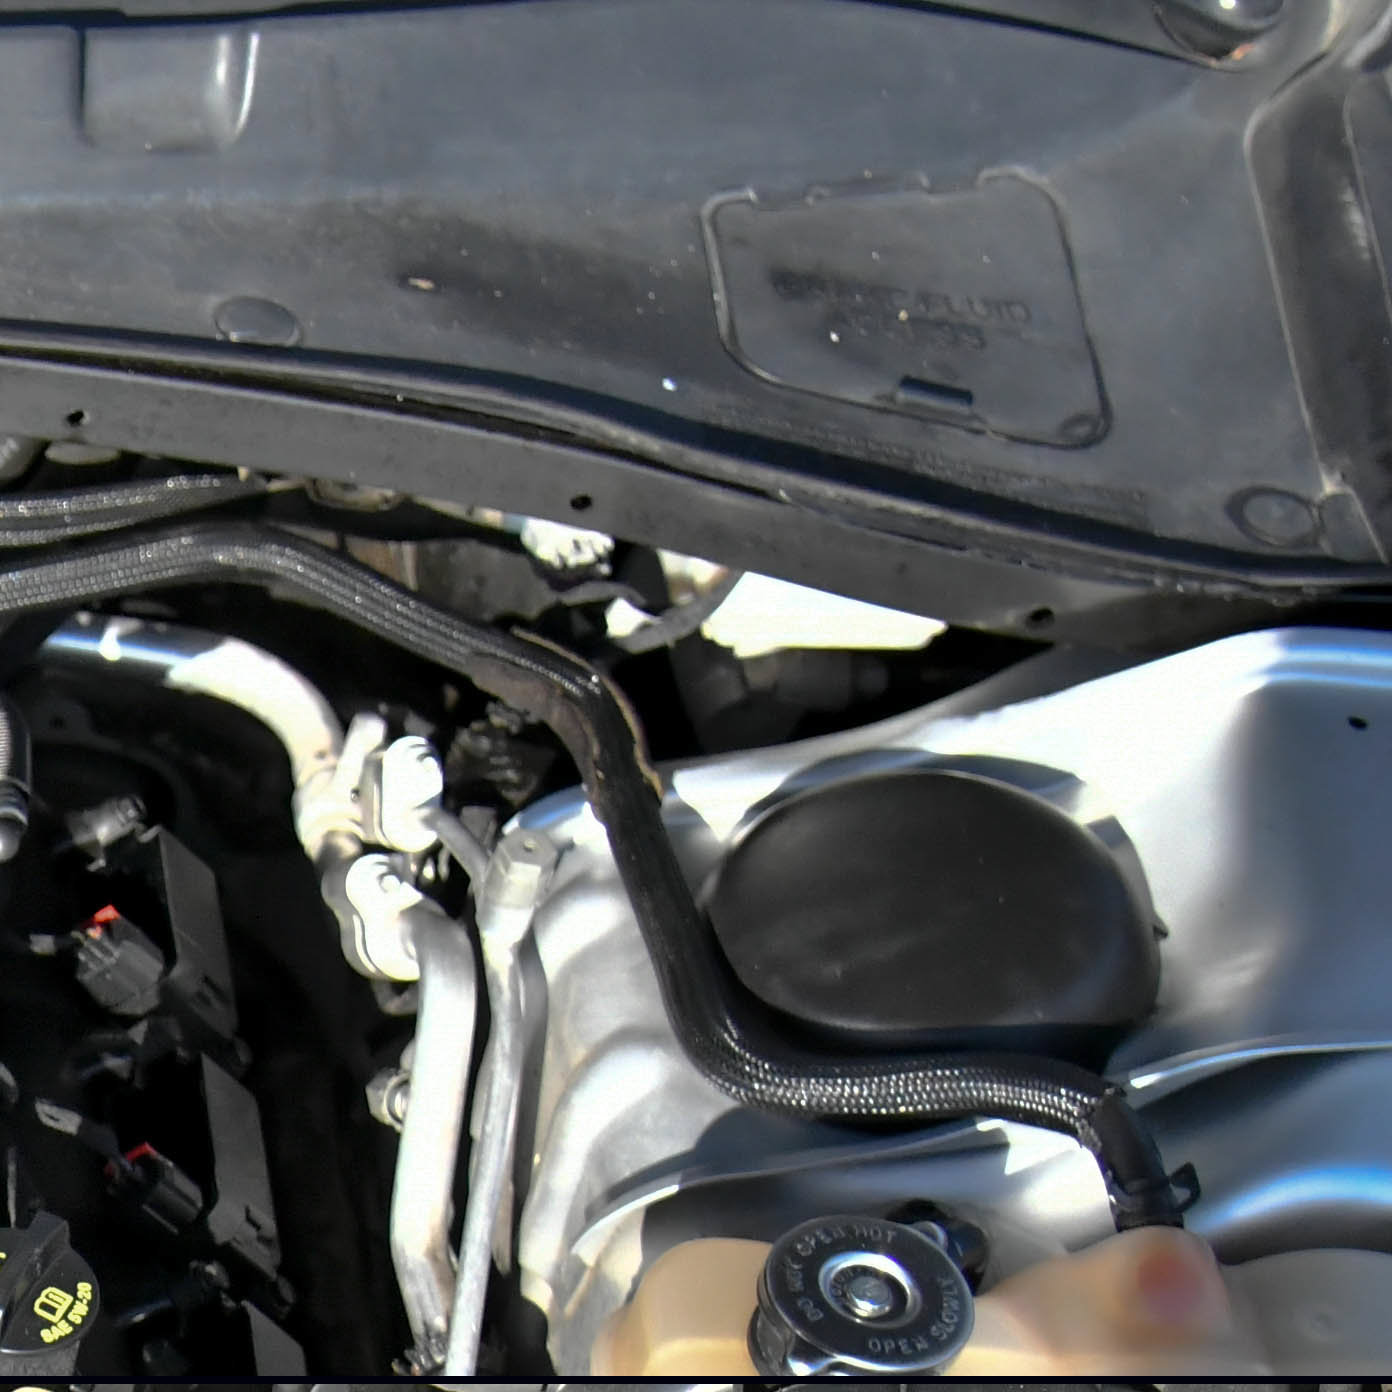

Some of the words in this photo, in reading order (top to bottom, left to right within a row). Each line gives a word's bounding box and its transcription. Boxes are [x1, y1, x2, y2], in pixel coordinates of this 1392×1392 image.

[914, 291, 1033, 324] FLUID
[795, 1225, 846, 1257] OPEN
[854, 1224, 897, 1243] HOT
[41, 1320, 73, 1343] SAE
[68, 1282, 92, 1325] 5W-20
[868, 1336, 929, 1355] OPEN
[929, 1275, 961, 1341] SLOWLY
